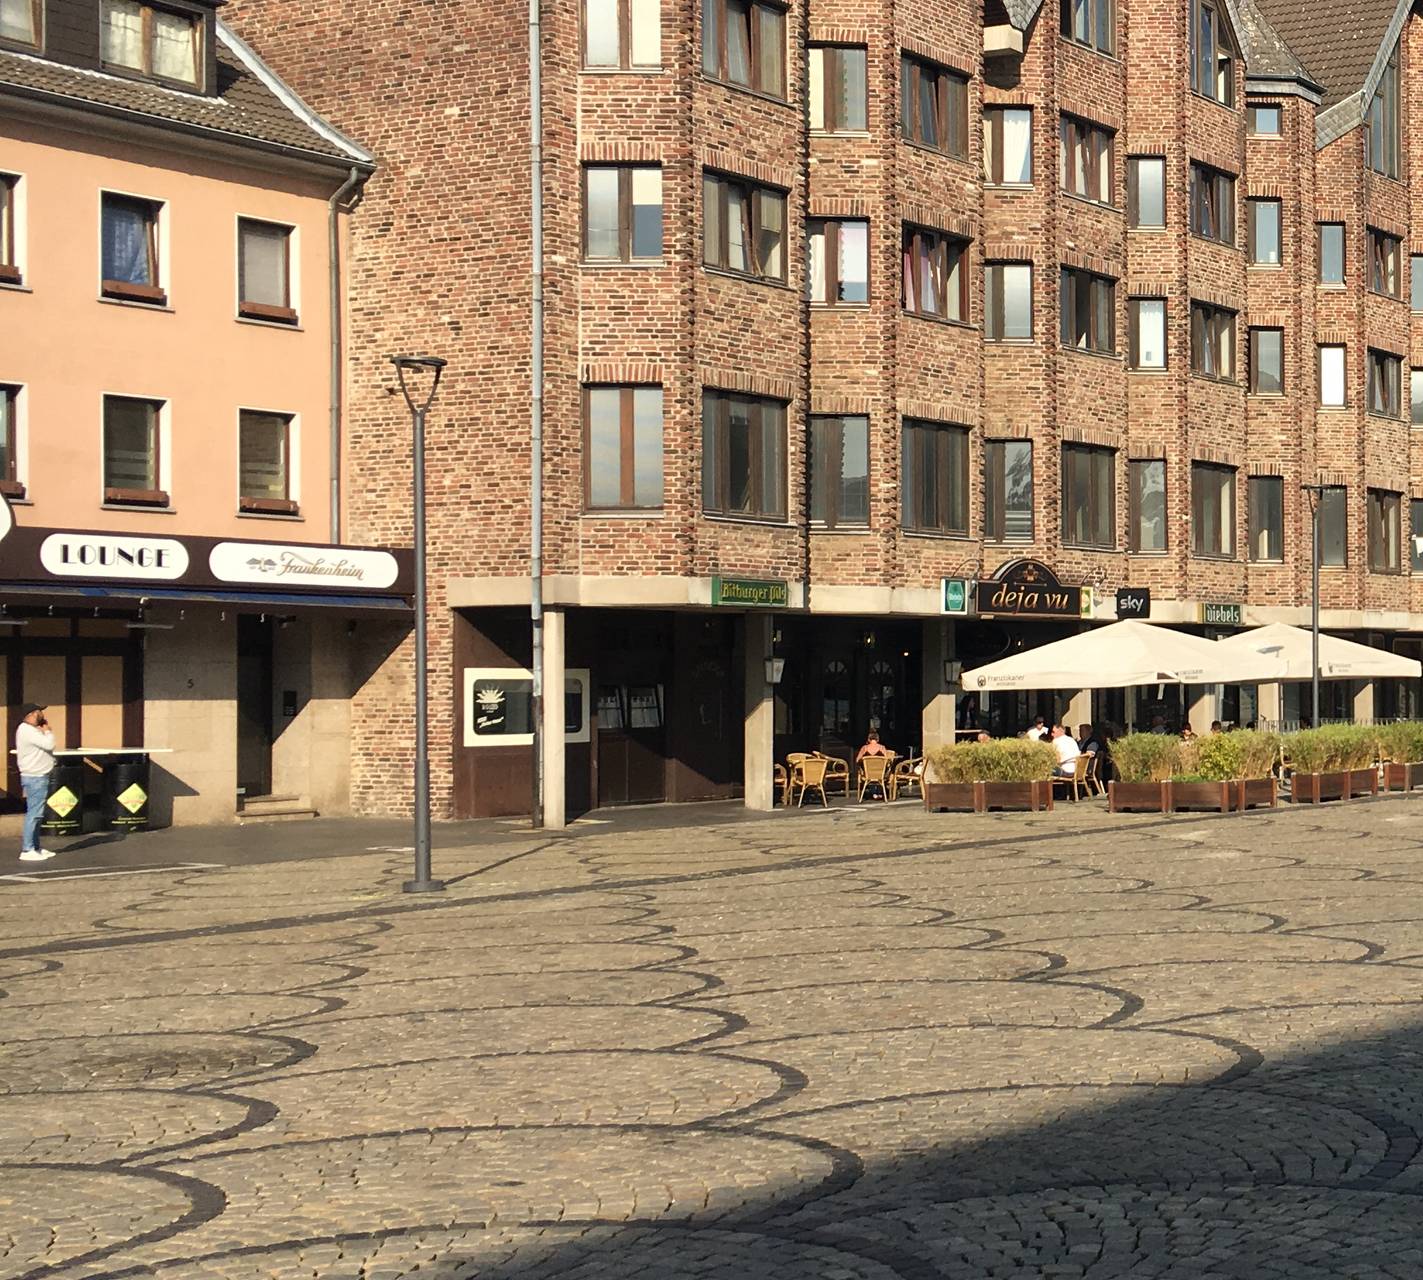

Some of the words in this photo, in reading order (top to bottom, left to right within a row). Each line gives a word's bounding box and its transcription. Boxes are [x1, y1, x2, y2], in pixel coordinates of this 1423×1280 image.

[60, 543, 171, 569] LOUNGE
[279, 551, 365, 581] Frankenheim
[722, 583, 768, 605] Bitburger
[991, 583, 1039, 614] deja
[1044, 593, 1069, 609] vu
[1120, 596, 1144, 612] sky
[187, 679, 194, 688] 5
